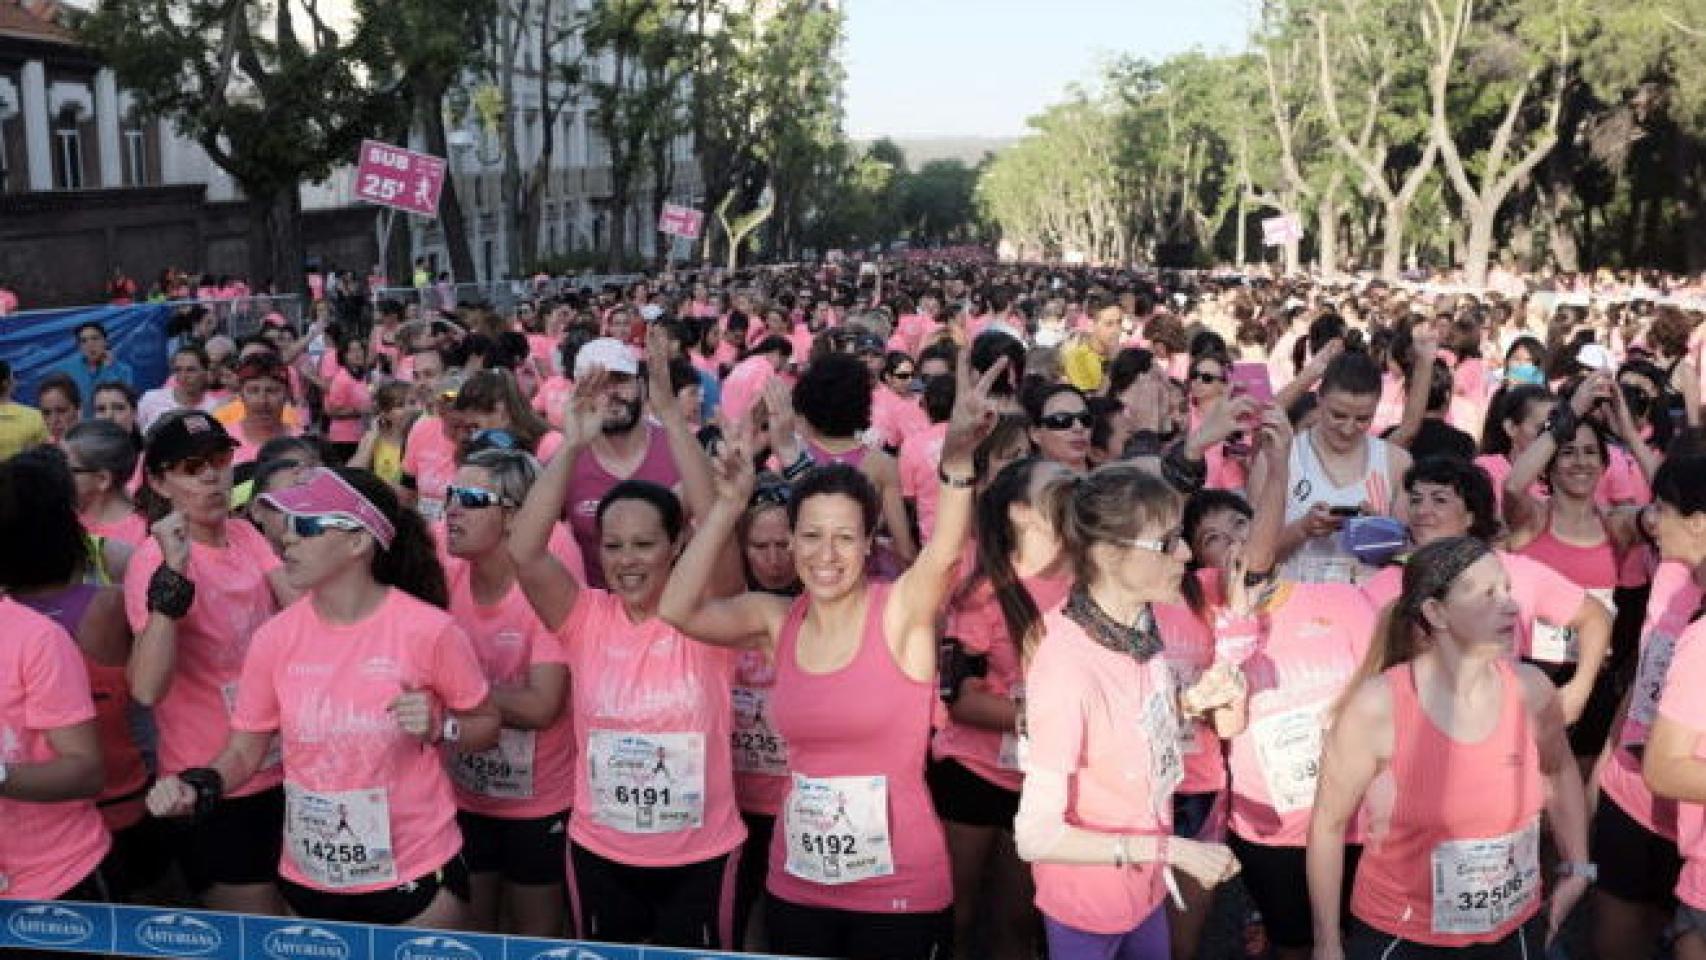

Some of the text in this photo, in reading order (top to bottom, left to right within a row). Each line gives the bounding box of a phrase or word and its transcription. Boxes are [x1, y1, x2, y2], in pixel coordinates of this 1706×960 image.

[370, 148, 409, 170] SUB
[361, 174, 405, 199] 25'
[615, 786, 671, 805] 6191
[303, 838, 367, 864] 14258
[801, 832, 858, 854] 6192
[1458, 871, 1523, 912] 32506
